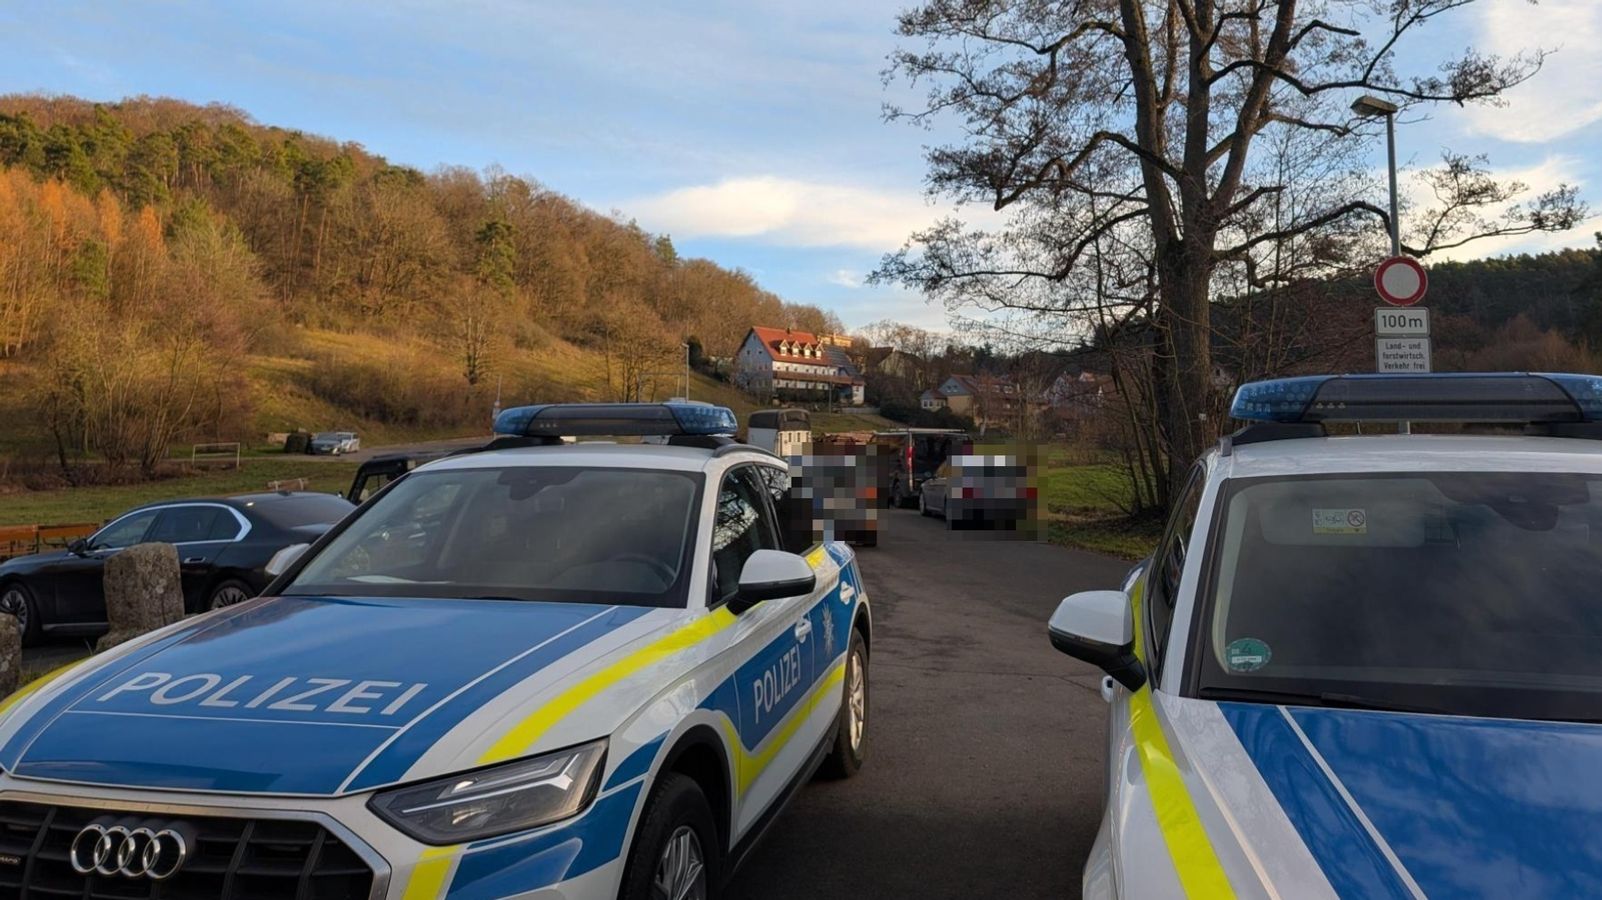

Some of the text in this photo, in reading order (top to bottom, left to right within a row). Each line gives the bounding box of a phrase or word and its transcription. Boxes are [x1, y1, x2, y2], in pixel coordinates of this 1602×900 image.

[1385, 342, 1421, 350] Land- und
[1384, 361, 1425, 370] Verkehr frei
[97, 671, 429, 716] POLIZEI
[753, 643, 801, 725] POLIZEI
